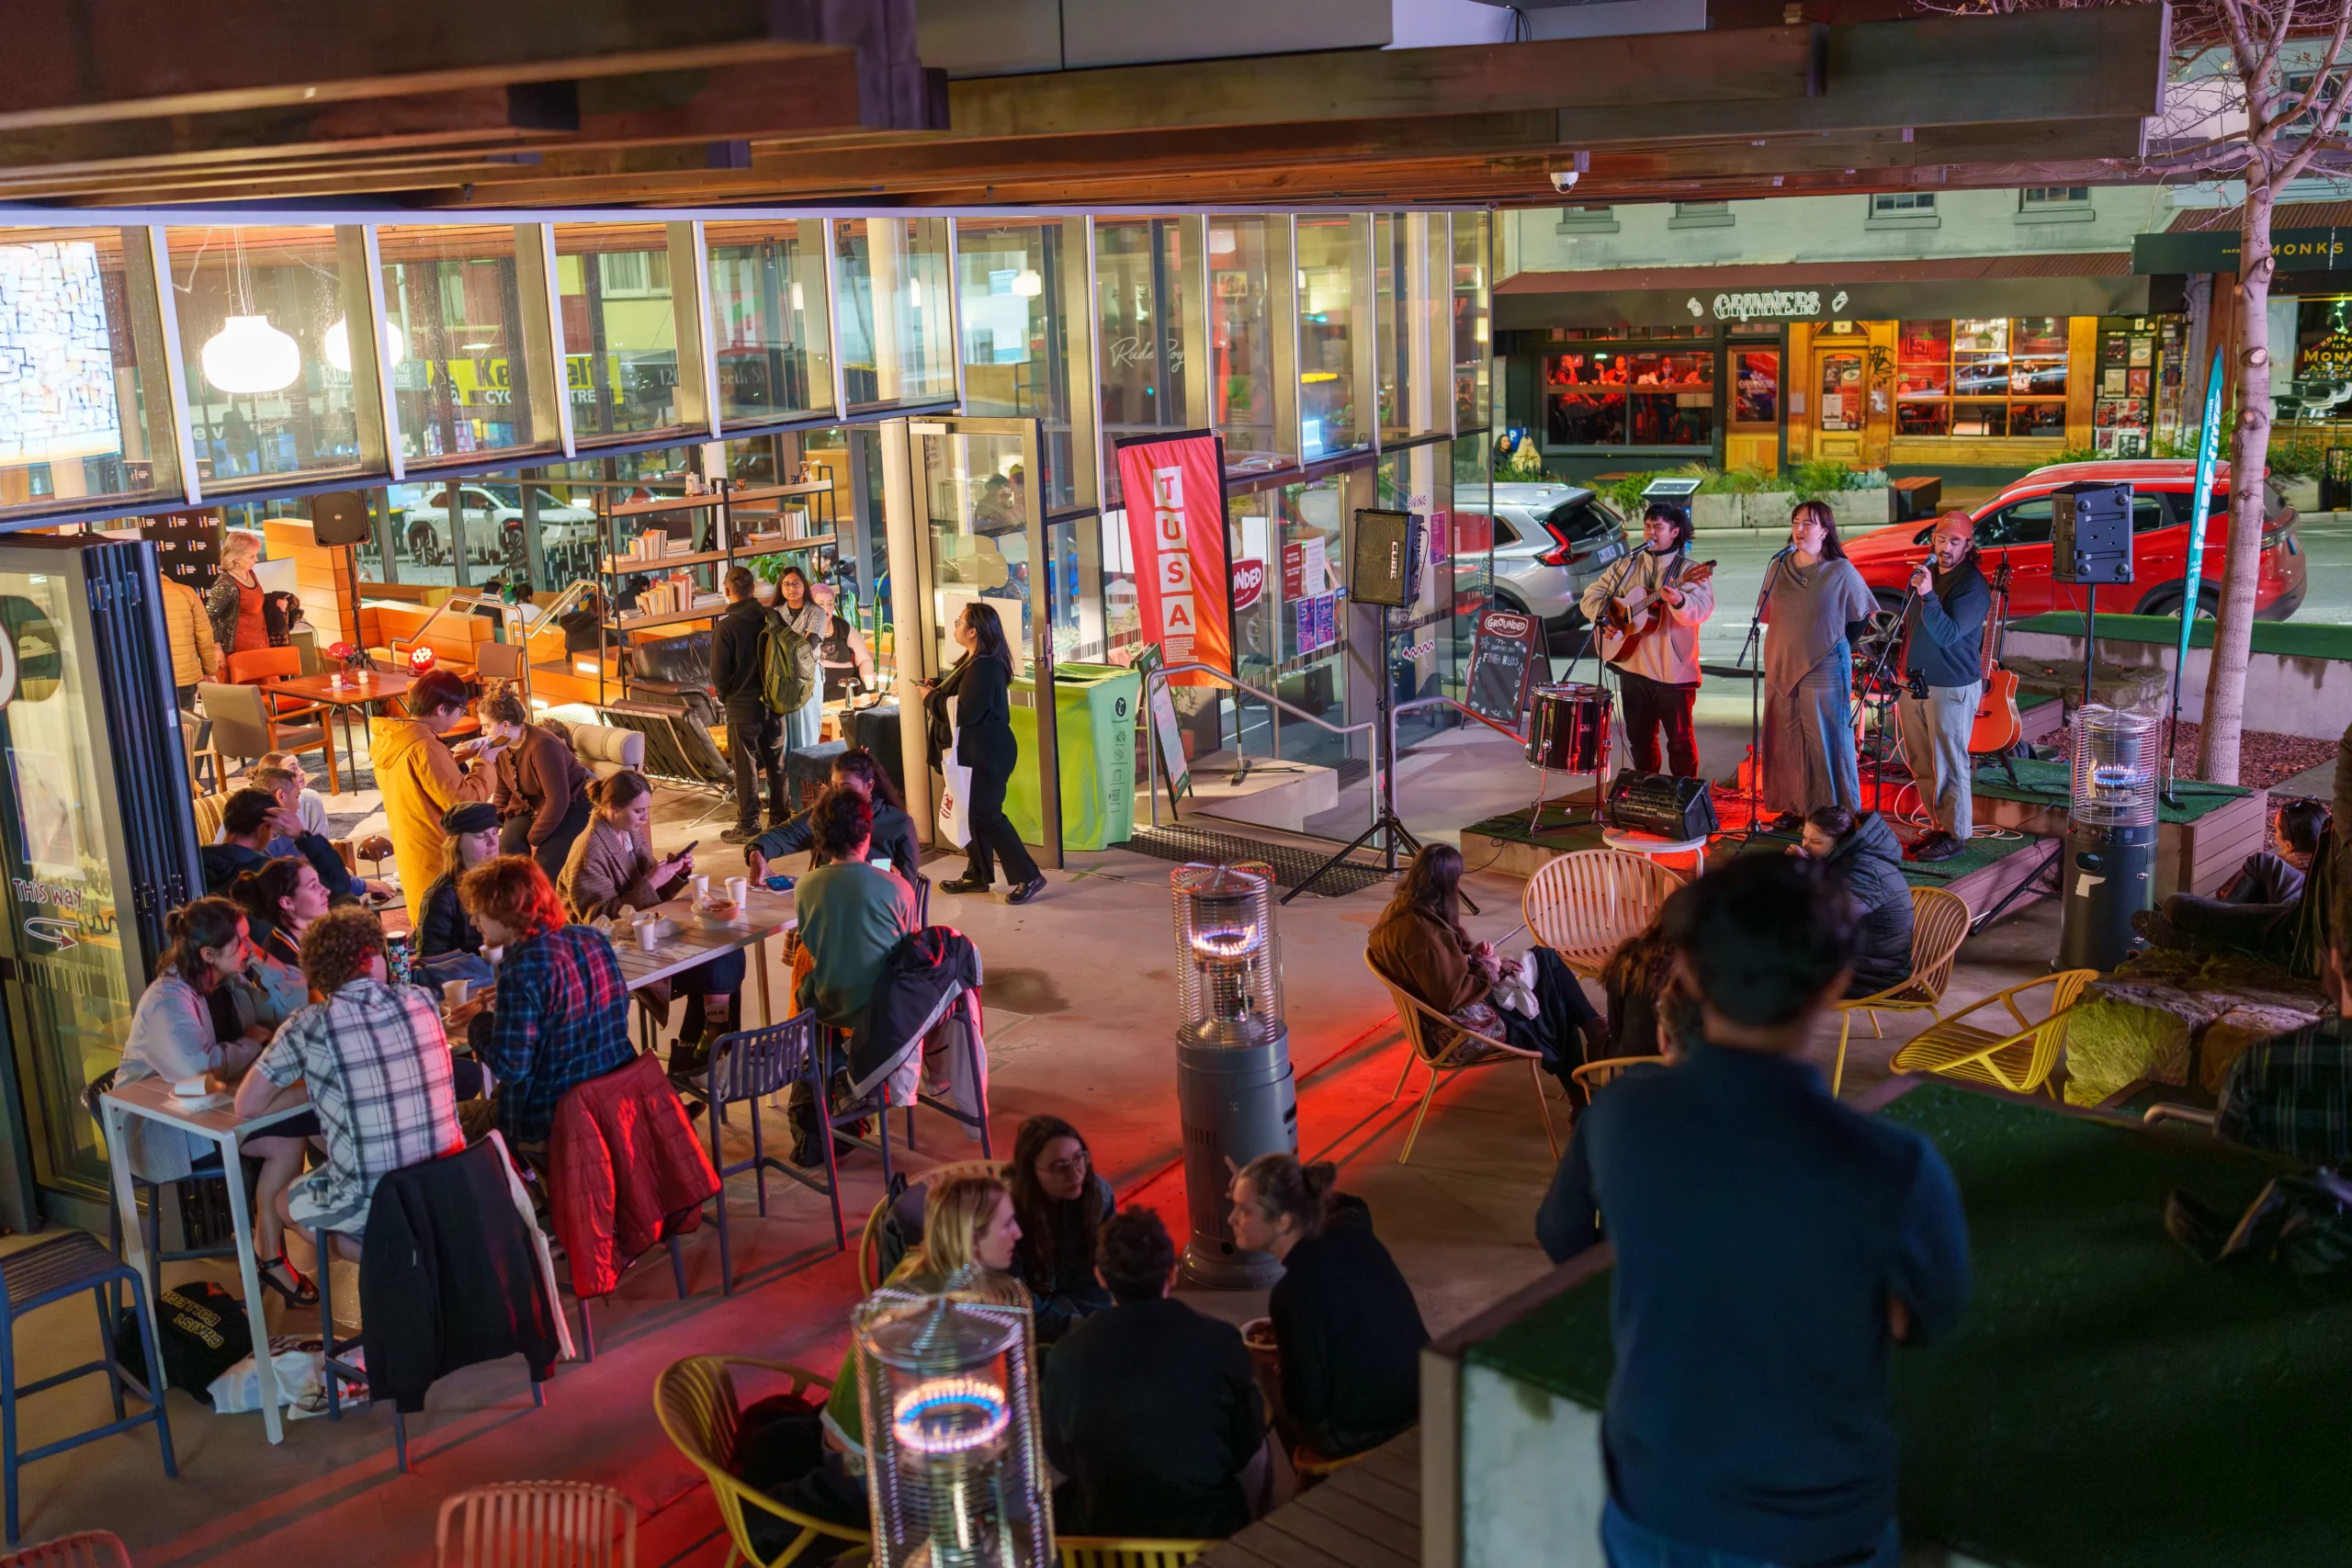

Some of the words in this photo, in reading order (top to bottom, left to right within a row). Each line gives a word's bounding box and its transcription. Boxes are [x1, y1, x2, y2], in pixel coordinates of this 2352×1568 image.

[2270, 242, 2344, 255] MONKS
[1713, 290, 1821, 321] GRINNERS
[1110, 336, 1154, 368] Rude
[2303, 349, 2352, 363] MONK
[1510, 430, 1517, 441] P
[1159, 476, 1191, 627] TUSA
[1390, 541, 1399, 580] CUBE
[1487, 617, 1526, 631] GROUNDED
[1483, 654, 1500, 664] FOOD
[1657, 810, 1676, 819] Roland
[161, 1290, 220, 1326] COLLEGE
[173, 1313, 224, 1348] CHRIST
